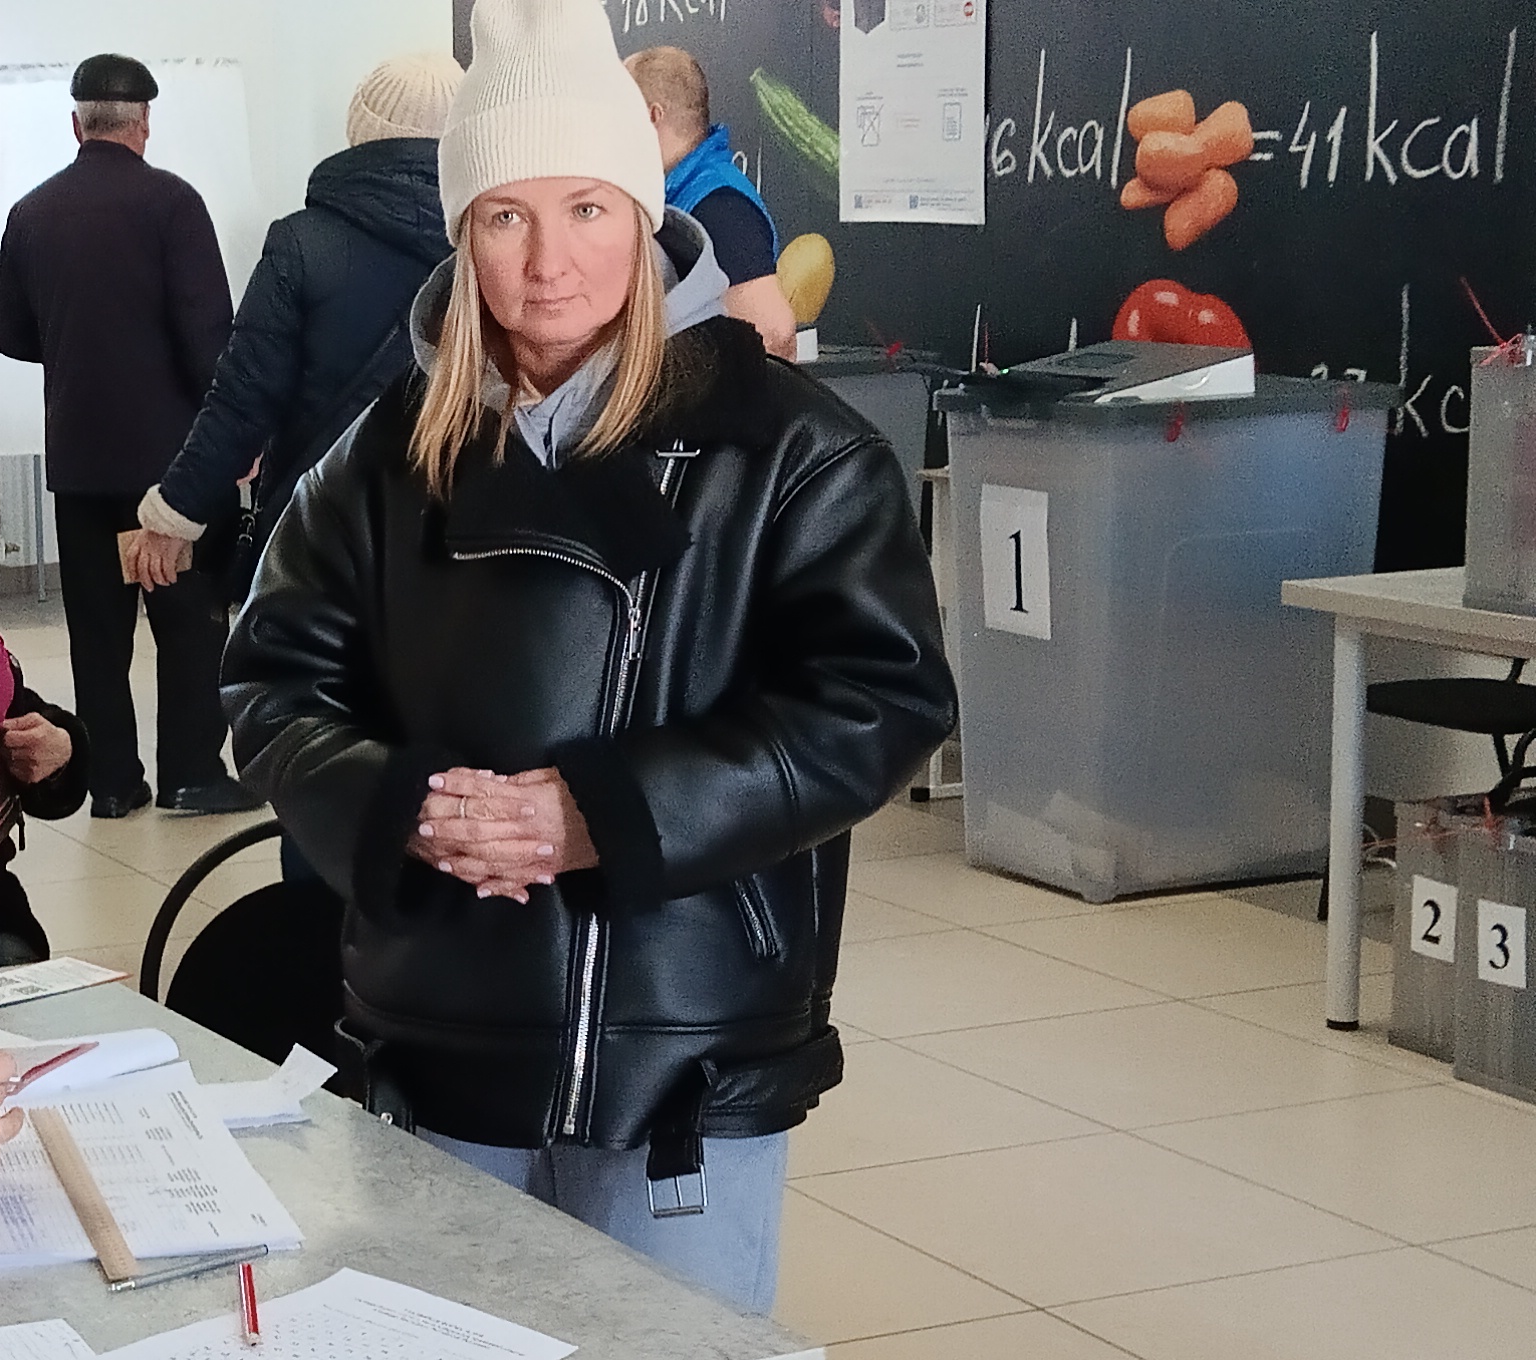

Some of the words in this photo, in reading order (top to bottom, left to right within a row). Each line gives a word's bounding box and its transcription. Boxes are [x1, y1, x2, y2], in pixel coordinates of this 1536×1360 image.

[1008, 529, 1029, 614] 1
[1421, 898, 1443, 945] 2
[1488, 923, 1510, 970] 3
